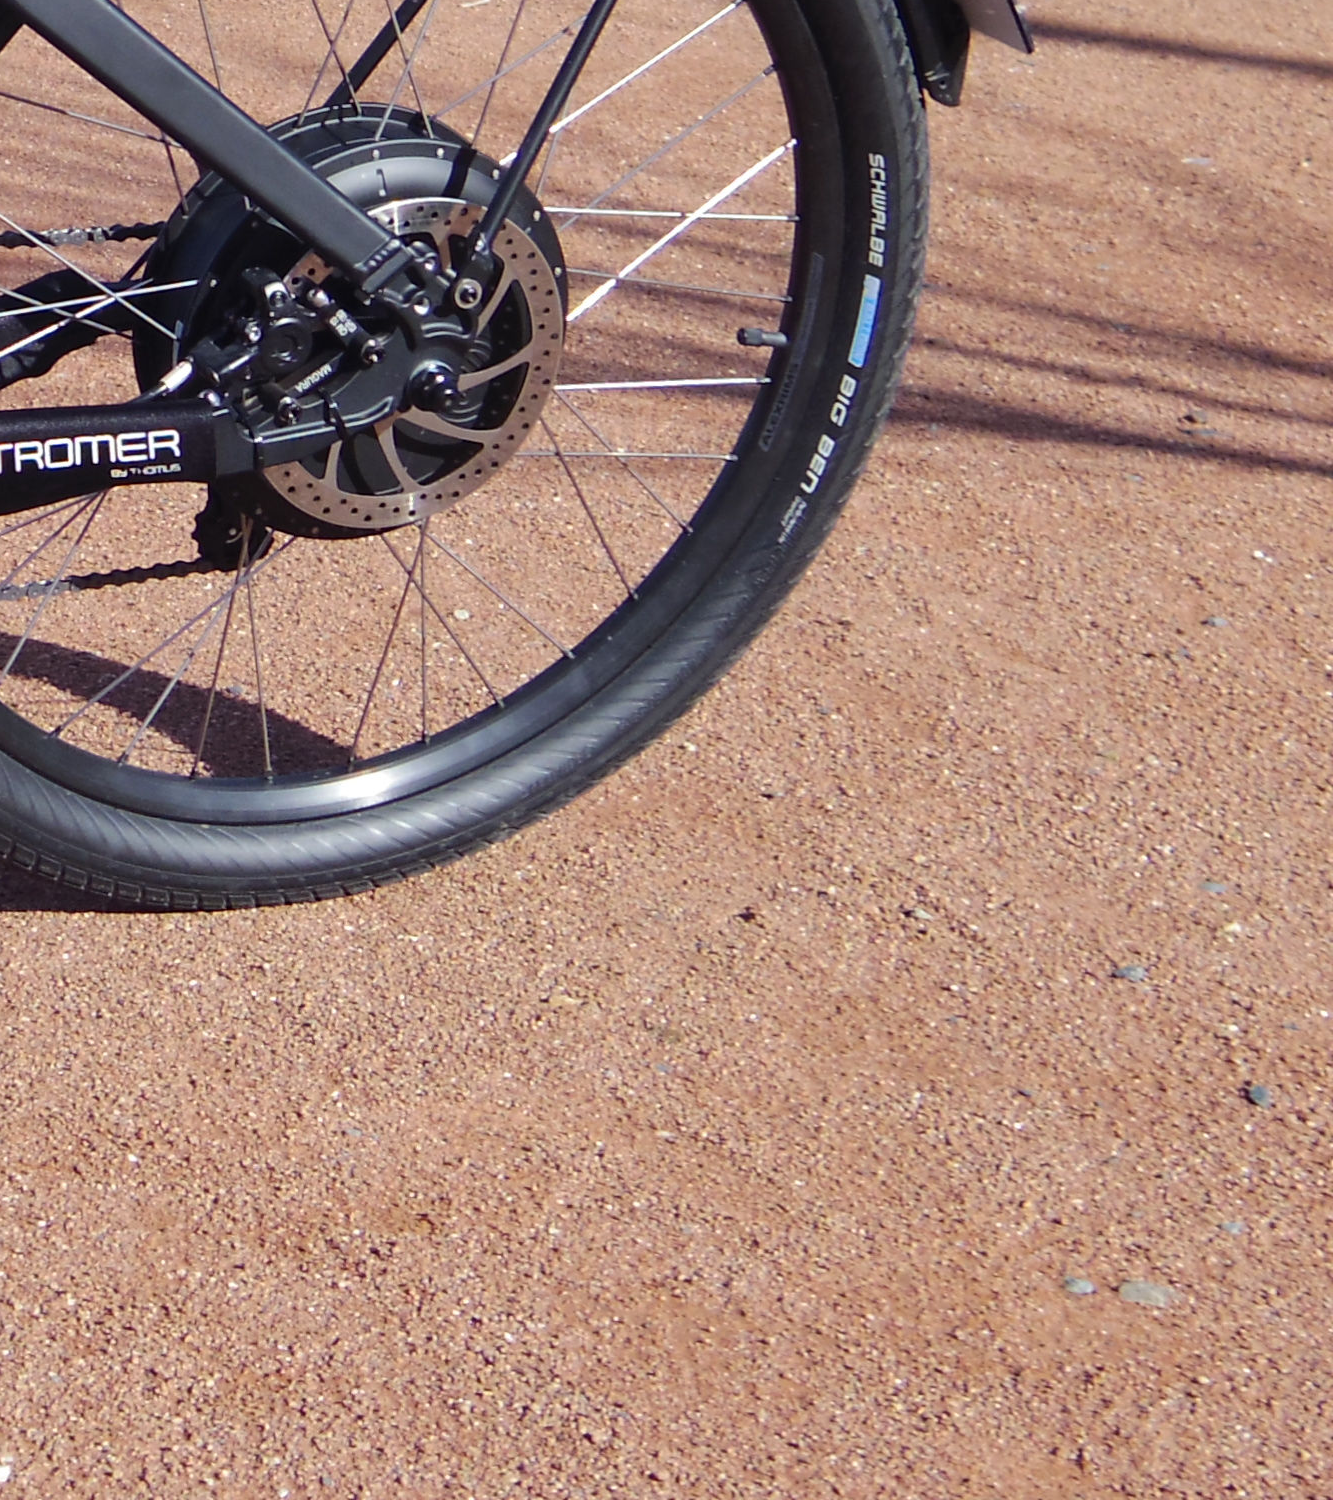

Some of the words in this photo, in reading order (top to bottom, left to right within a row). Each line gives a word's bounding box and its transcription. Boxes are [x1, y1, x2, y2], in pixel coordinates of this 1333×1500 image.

[868, 152, 886, 268] SCHWALBE
[294, 364, 332, 393] MAGURA
[830, 374, 857, 427] BIG
[800, 434, 835, 493] BEN
